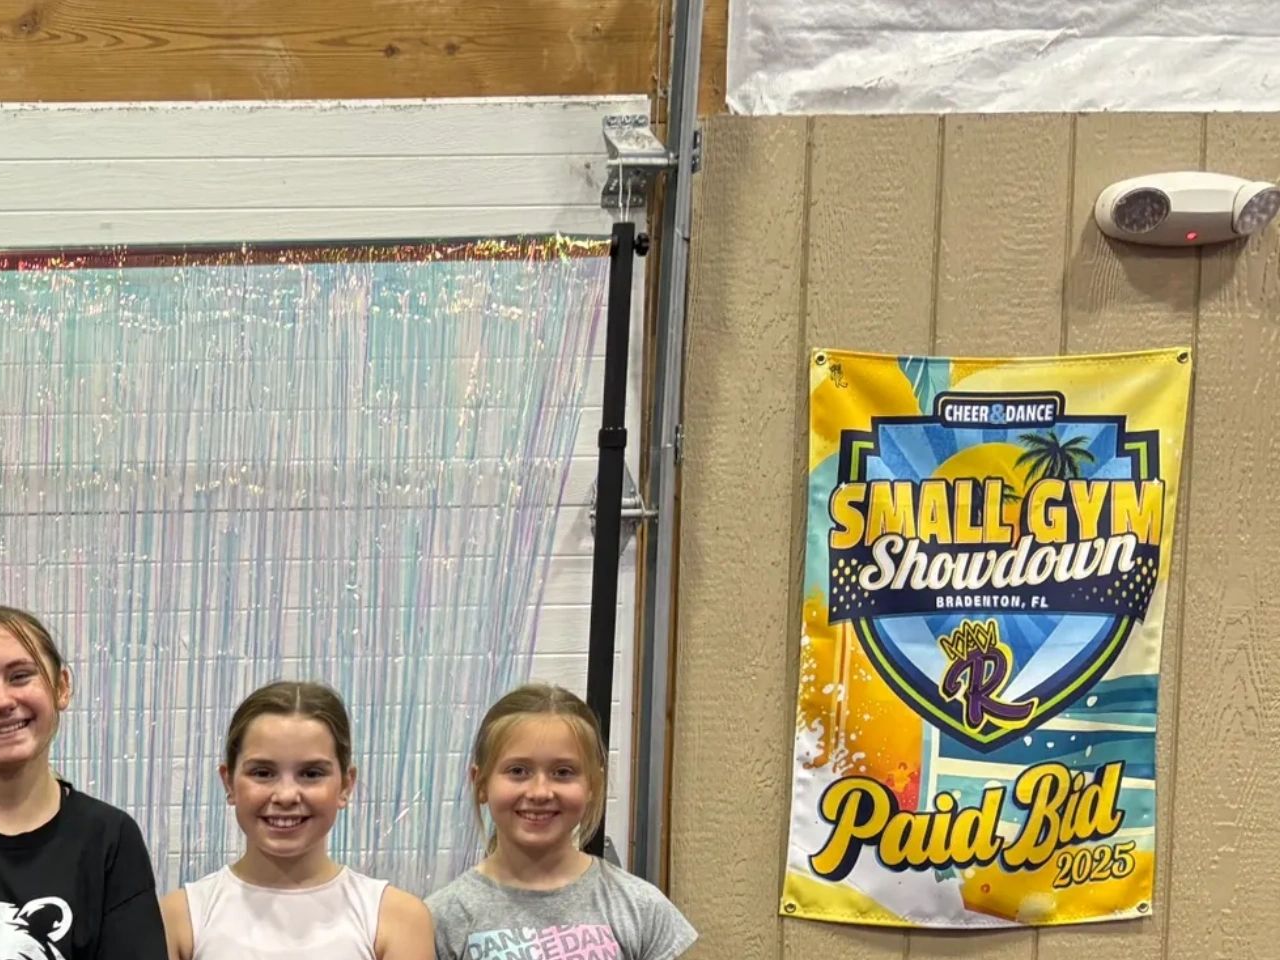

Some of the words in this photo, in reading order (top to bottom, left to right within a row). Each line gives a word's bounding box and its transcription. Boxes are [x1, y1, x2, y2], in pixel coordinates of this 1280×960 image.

[830, 479, 1014, 549] SMALL
[1028, 480, 1165, 546] GYM
[859, 533, 1136, 590] Showdown
[935, 595, 1026, 609] BRADENTON,
[1030, 596, 1049, 608] FL
[809, 775, 1004, 881] Paid
[1002, 760, 1126, 872] Bid
[1052, 840, 1136, 888] 2025
